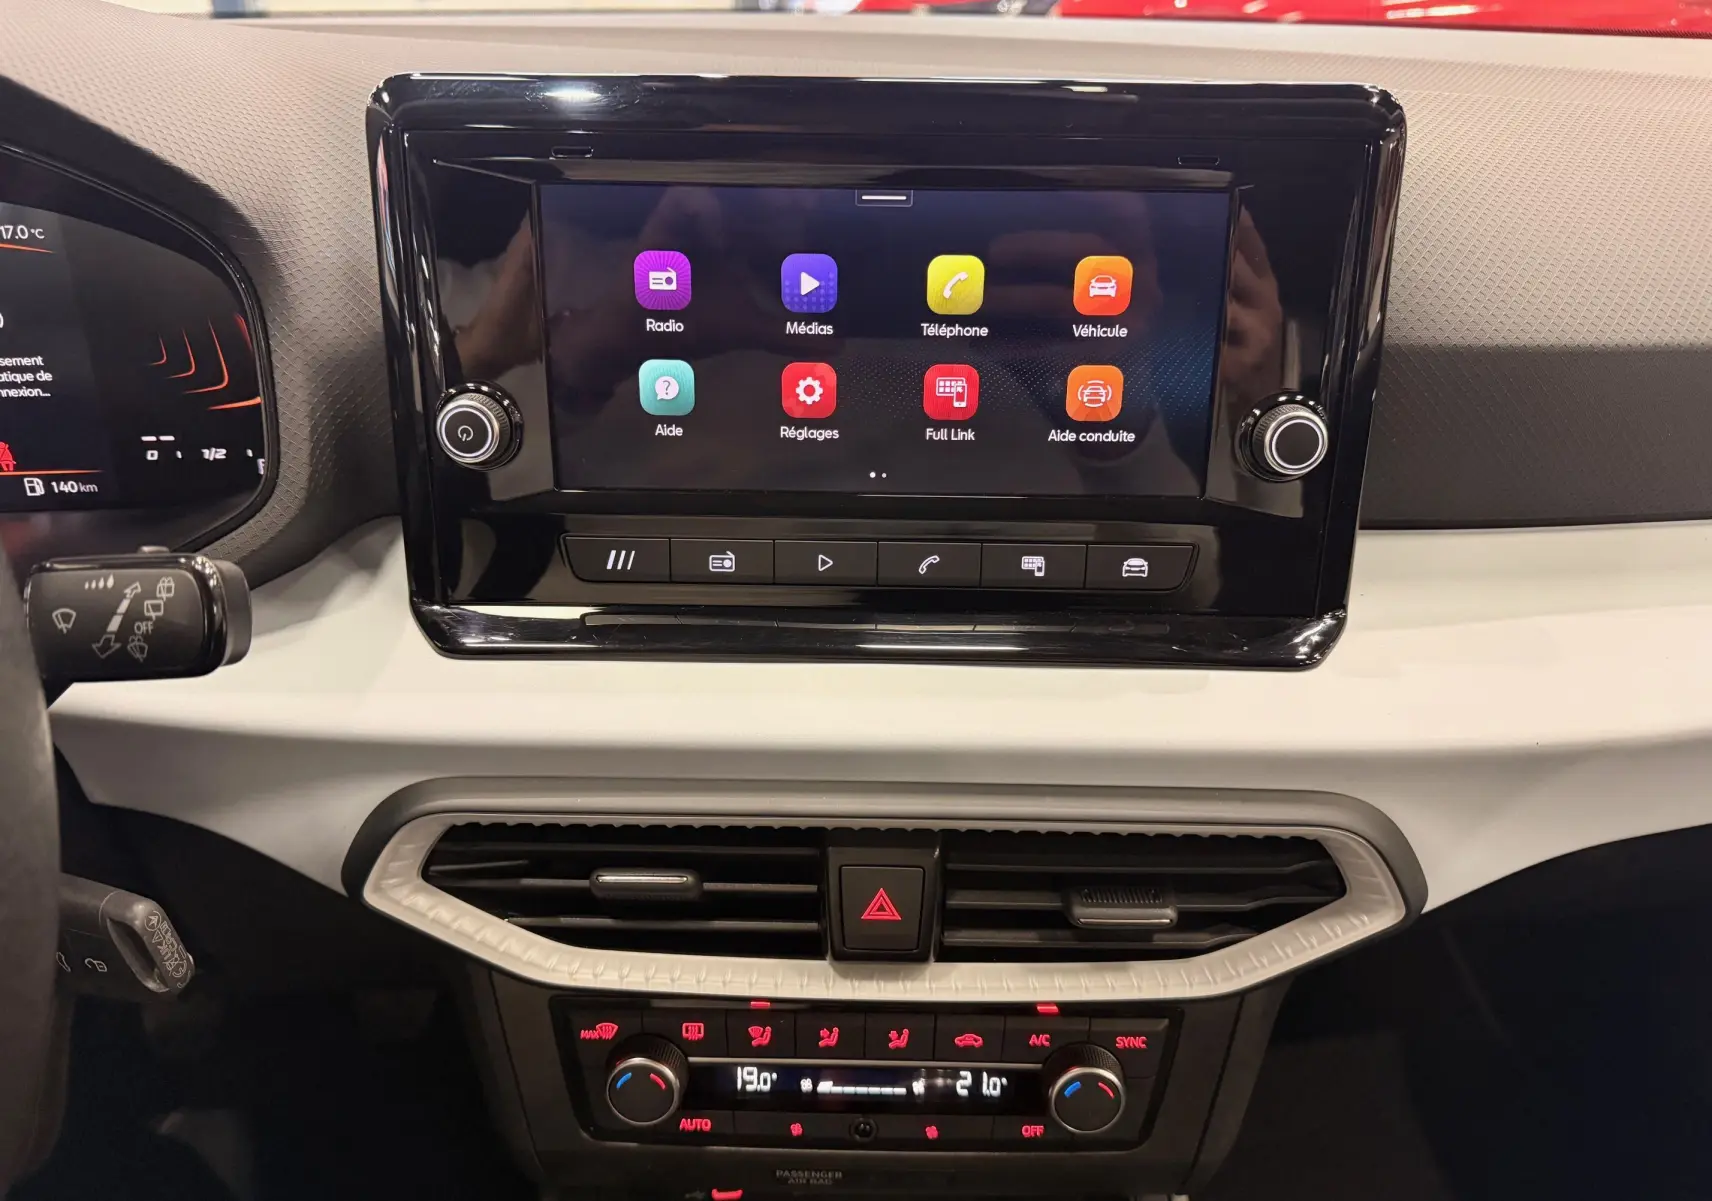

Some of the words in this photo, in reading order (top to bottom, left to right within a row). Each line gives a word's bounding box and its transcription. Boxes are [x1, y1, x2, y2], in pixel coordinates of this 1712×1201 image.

[30, 228, 45, 239] °C
[645, 318, 684, 332] Radio
[785, 321, 834, 335] Médias
[921, 323, 989, 339] Téléphone
[1072, 324, 1128, 338] Véhicule
[36, 370, 52, 381] de
[655, 424, 683, 437] Aide
[780, 426, 839, 441] Réglages
[926, 428, 948, 441] Full
[951, 429, 975, 441] Link
[1048, 429, 1077, 442] Aide
[1079, 430, 1135, 443] conduite
[201, 447, 227, 461] 1/2
[51, 481, 77, 493] 140
[79, 482, 98, 493] km
[134, 621, 154, 635] OFF
[580, 1029, 599, 1040] MAX
[1029, 1034, 1050, 1046] A/C
[1115, 1036, 1147, 1049] SYNC
[680, 1118, 711, 1131] AUTO
[1021, 1125, 1044, 1138] OFF
[776, 1169, 843, 1179] PASSENGER
